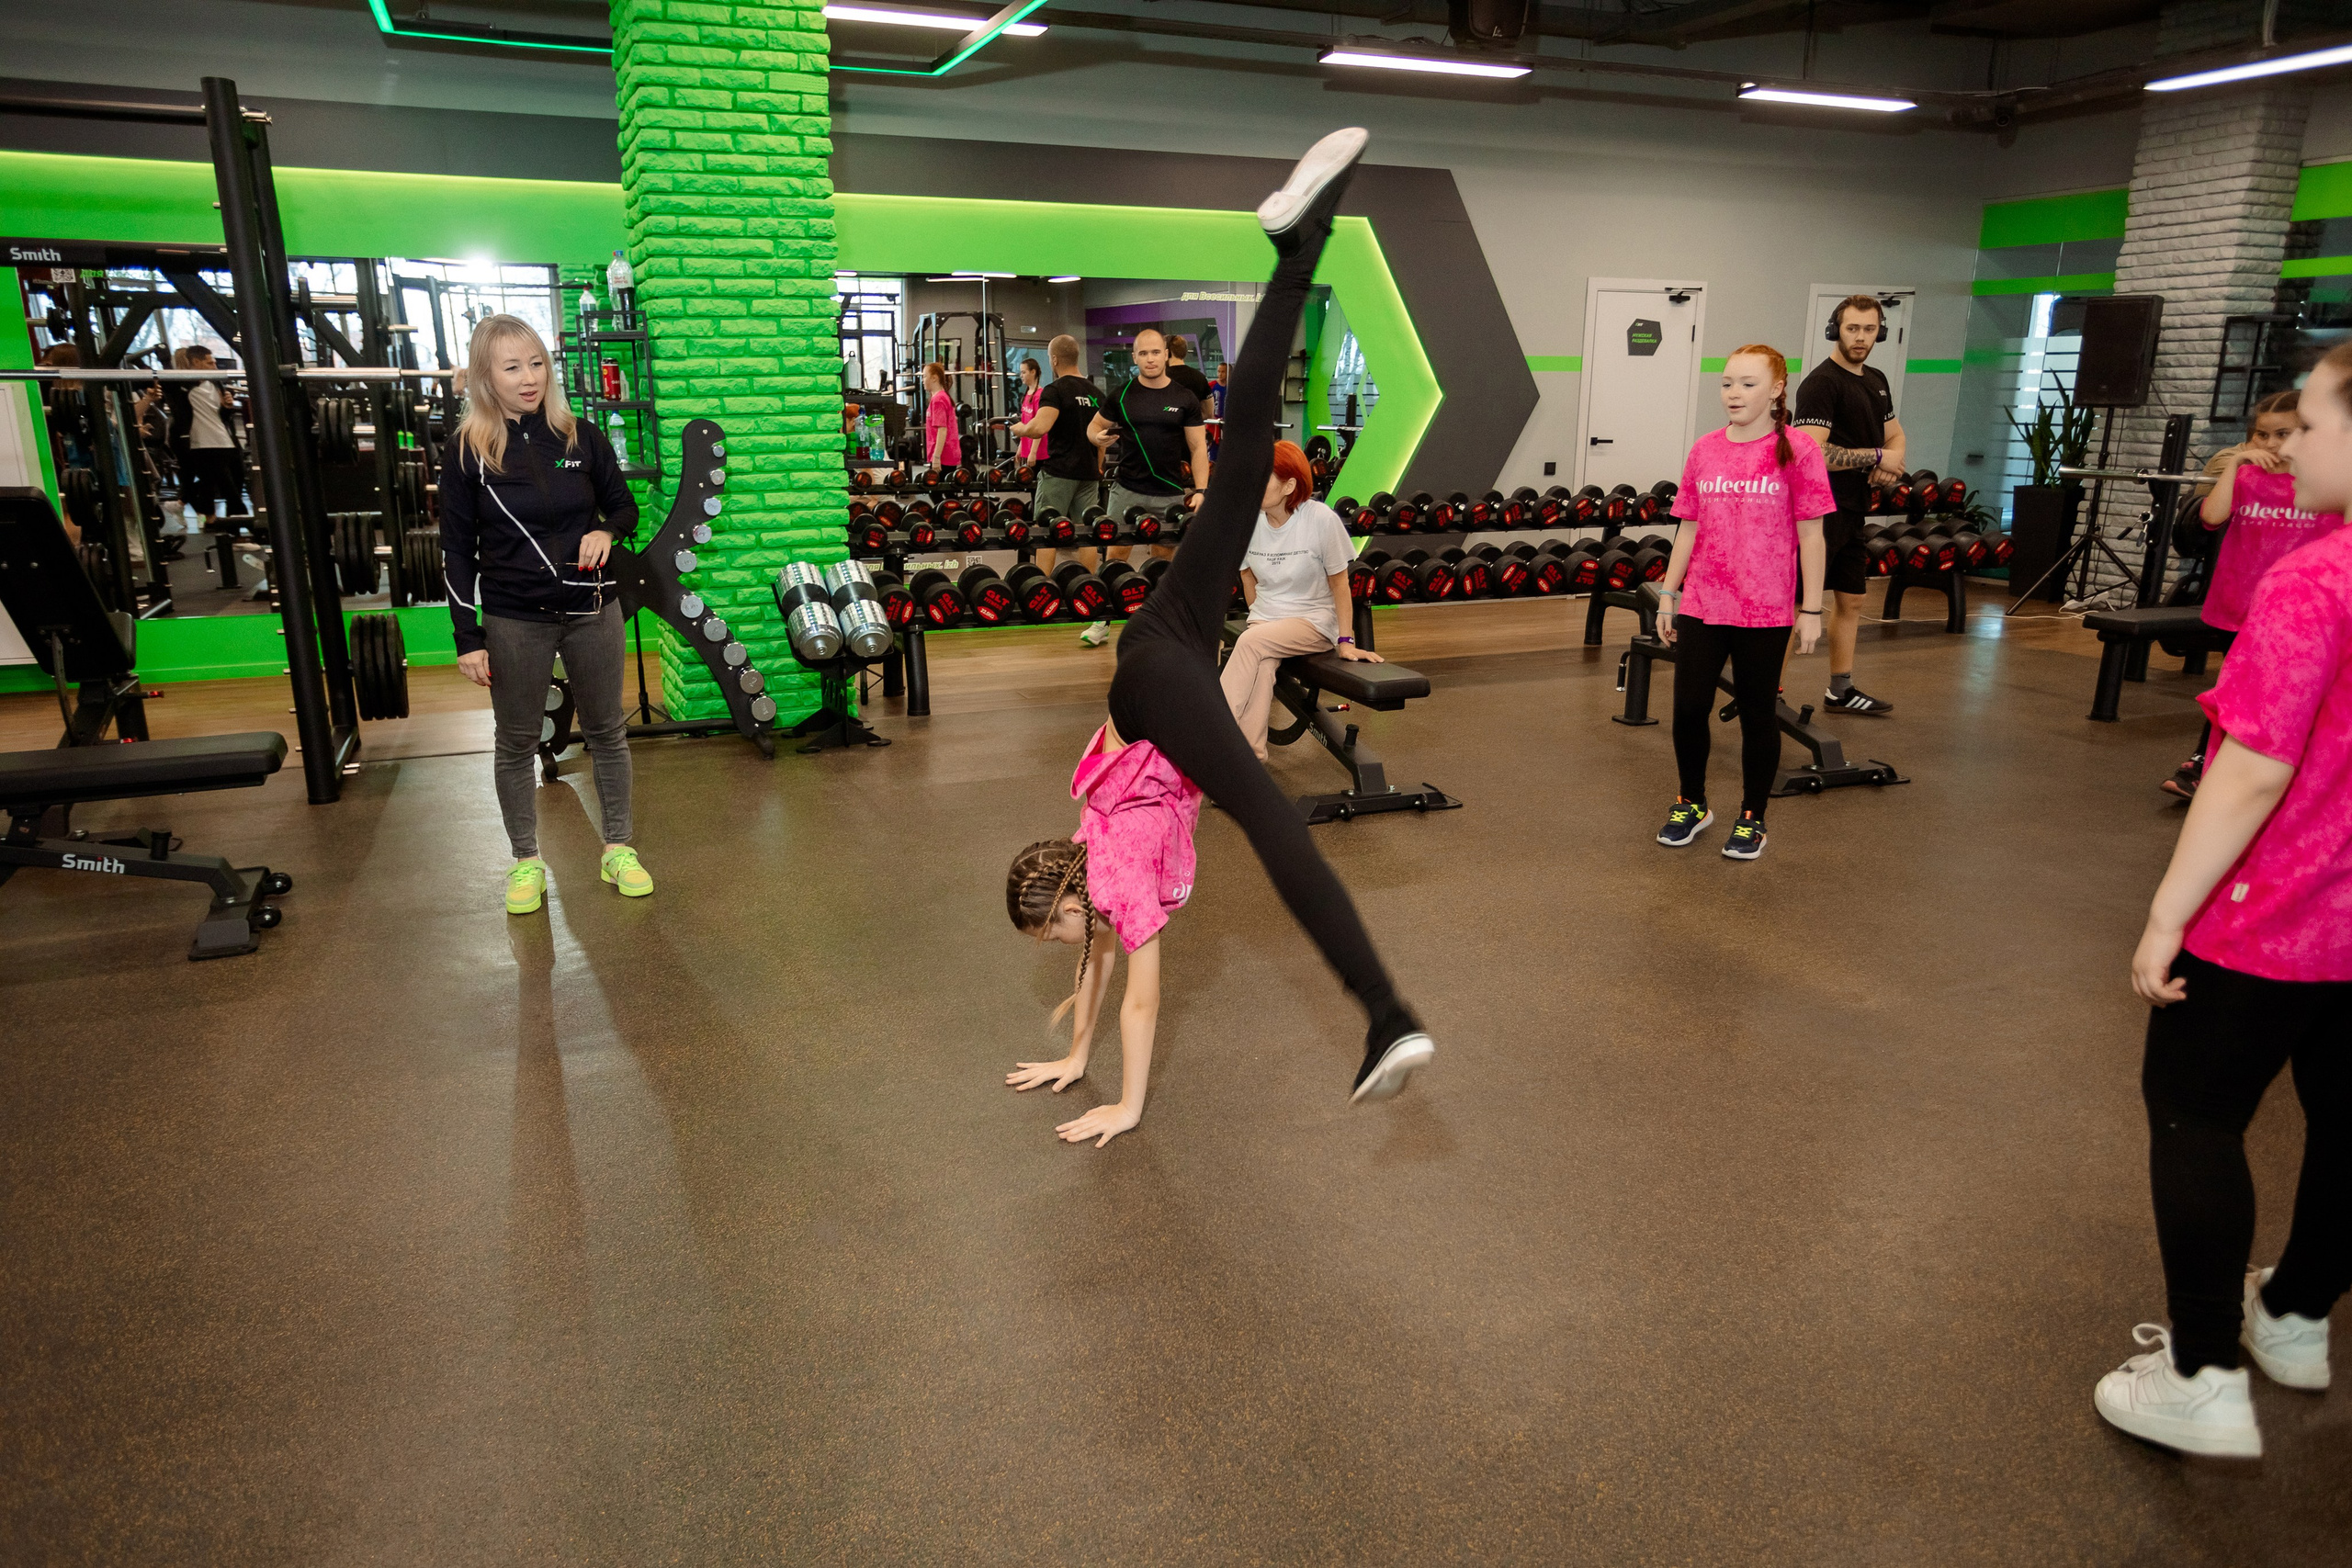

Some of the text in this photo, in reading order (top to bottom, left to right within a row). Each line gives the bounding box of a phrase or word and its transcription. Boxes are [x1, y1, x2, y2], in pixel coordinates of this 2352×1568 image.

[9, 247, 62, 262] Smith
[1181, 292, 1199, 301] для
[1806, 418, 1826, 426] MAN
[1395, 571, 1412, 585] GLT
[1429, 570, 1444, 591] GLT
[987, 590, 1009, 605] GLT
[1029, 586, 1047, 608] GLT
[1085, 585, 1103, 603] GLT
[1122, 585, 1146, 596] GLT
[885, 595, 897, 620] GLT
[941, 593, 959, 613] GLT
[62, 853, 125, 874] Smith
